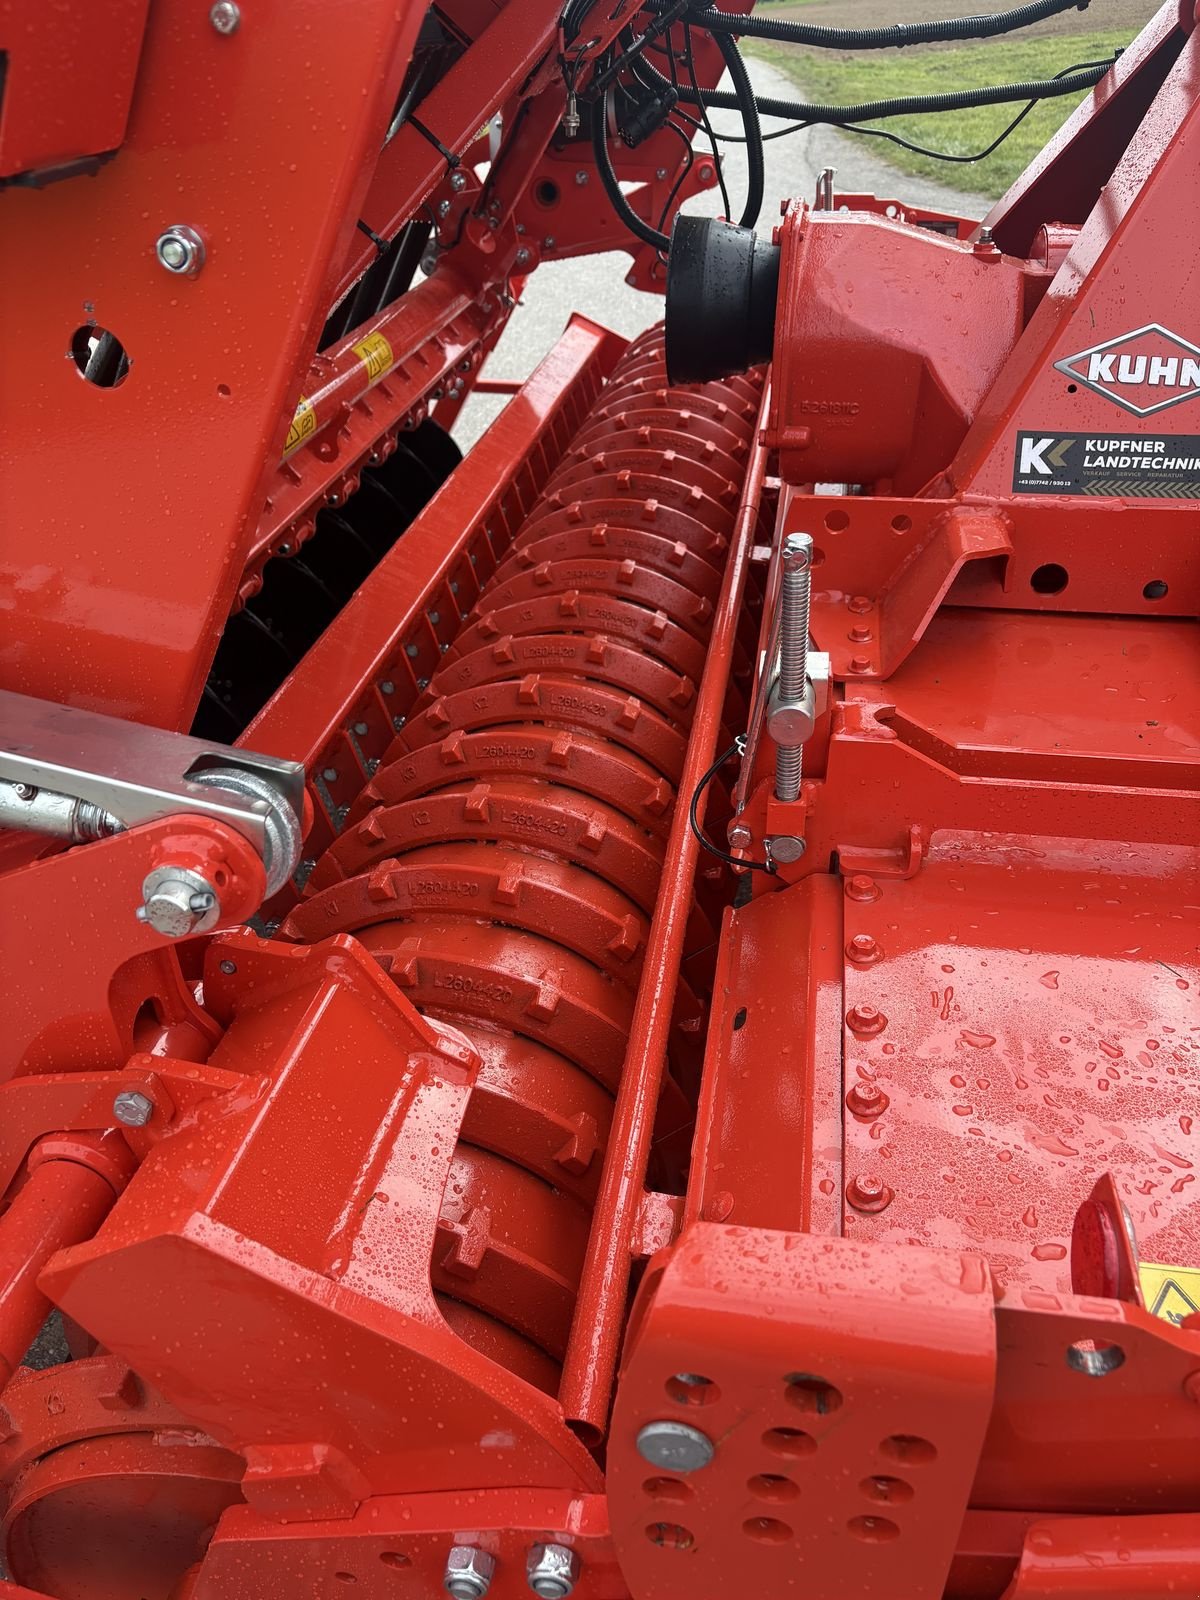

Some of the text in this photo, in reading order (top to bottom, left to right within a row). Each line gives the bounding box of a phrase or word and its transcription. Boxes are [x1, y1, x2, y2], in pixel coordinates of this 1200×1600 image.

[1087, 353, 1200, 387] KUHN
[1085, 439, 1165, 453] KUPFNER
[523, 646, 576, 658] L2604420
[551, 693, 607, 717] L2604420
[475, 745, 535, 759] L2604420
[502, 805, 568, 837] L2604420
[408, 881, 480, 897] L2604420
[435, 970, 513, 1003] L2604420
